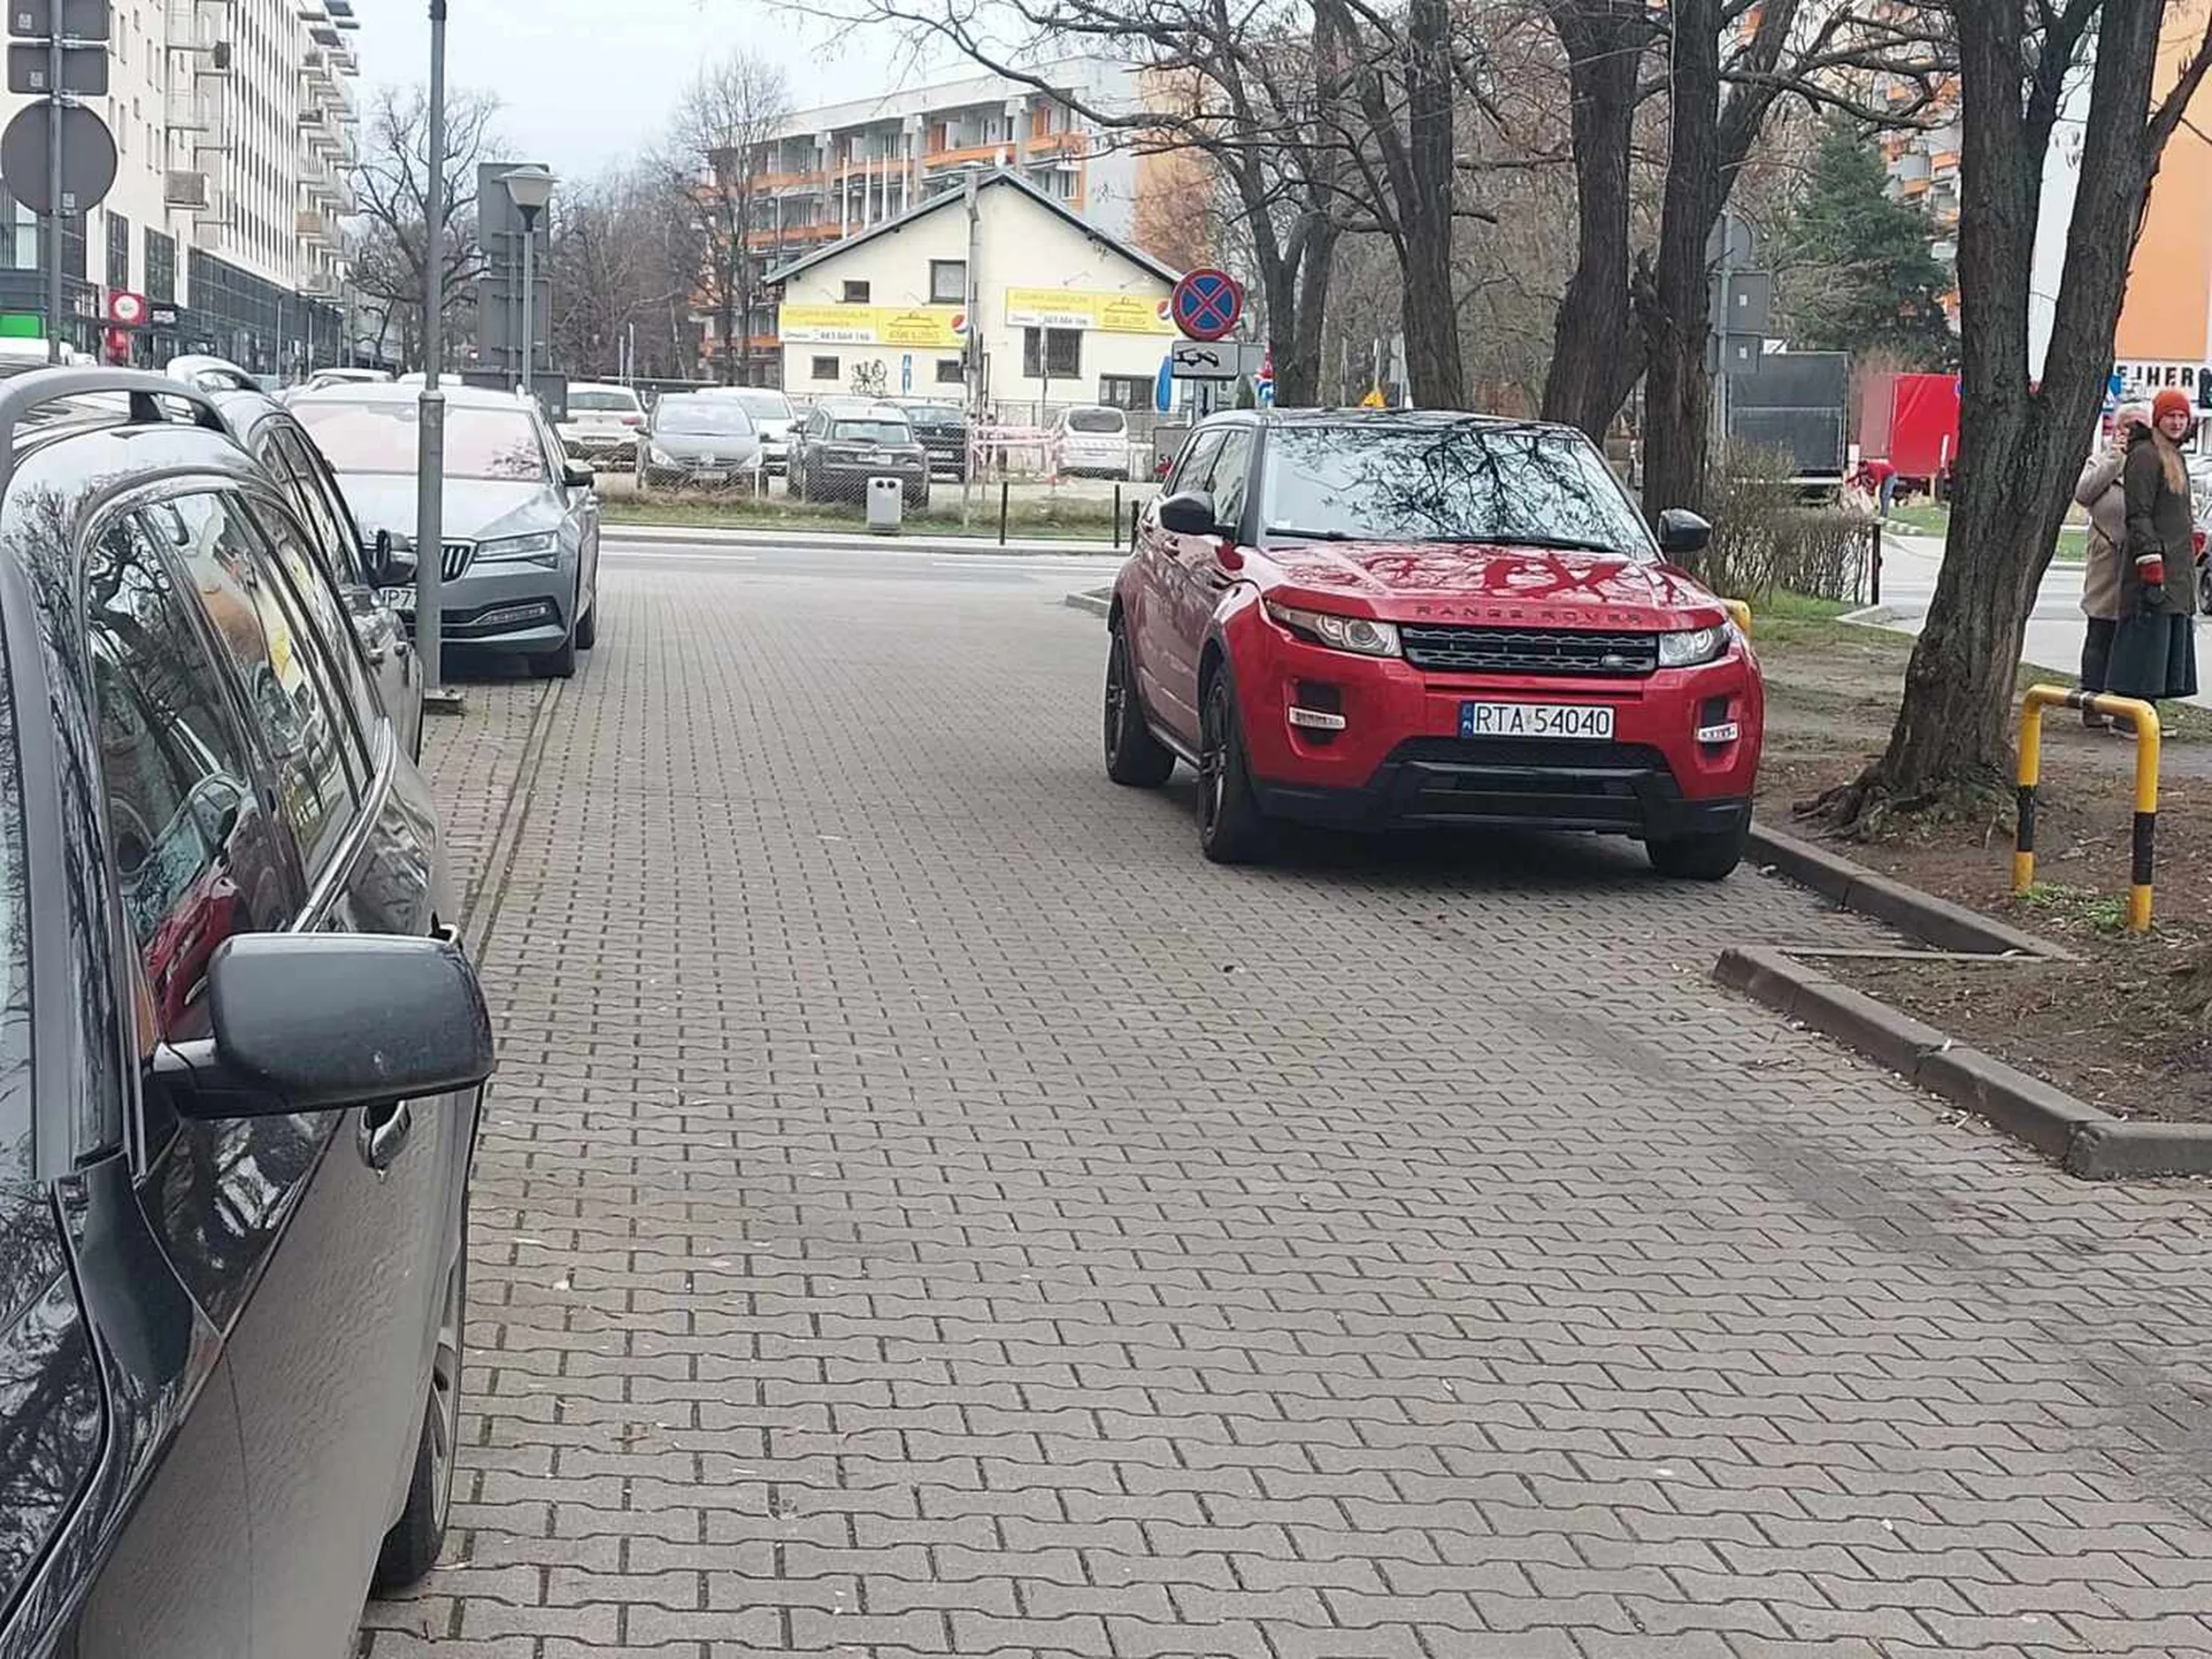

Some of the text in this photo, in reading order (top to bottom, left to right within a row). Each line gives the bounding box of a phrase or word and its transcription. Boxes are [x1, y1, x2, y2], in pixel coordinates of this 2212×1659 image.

[2116, 365, 2193, 387] EJHER
[1417, 605, 1641, 625] RANGE ROVER
[1475, 705, 1525, 733] RTA
[1534, 707, 1610, 736] 54040
